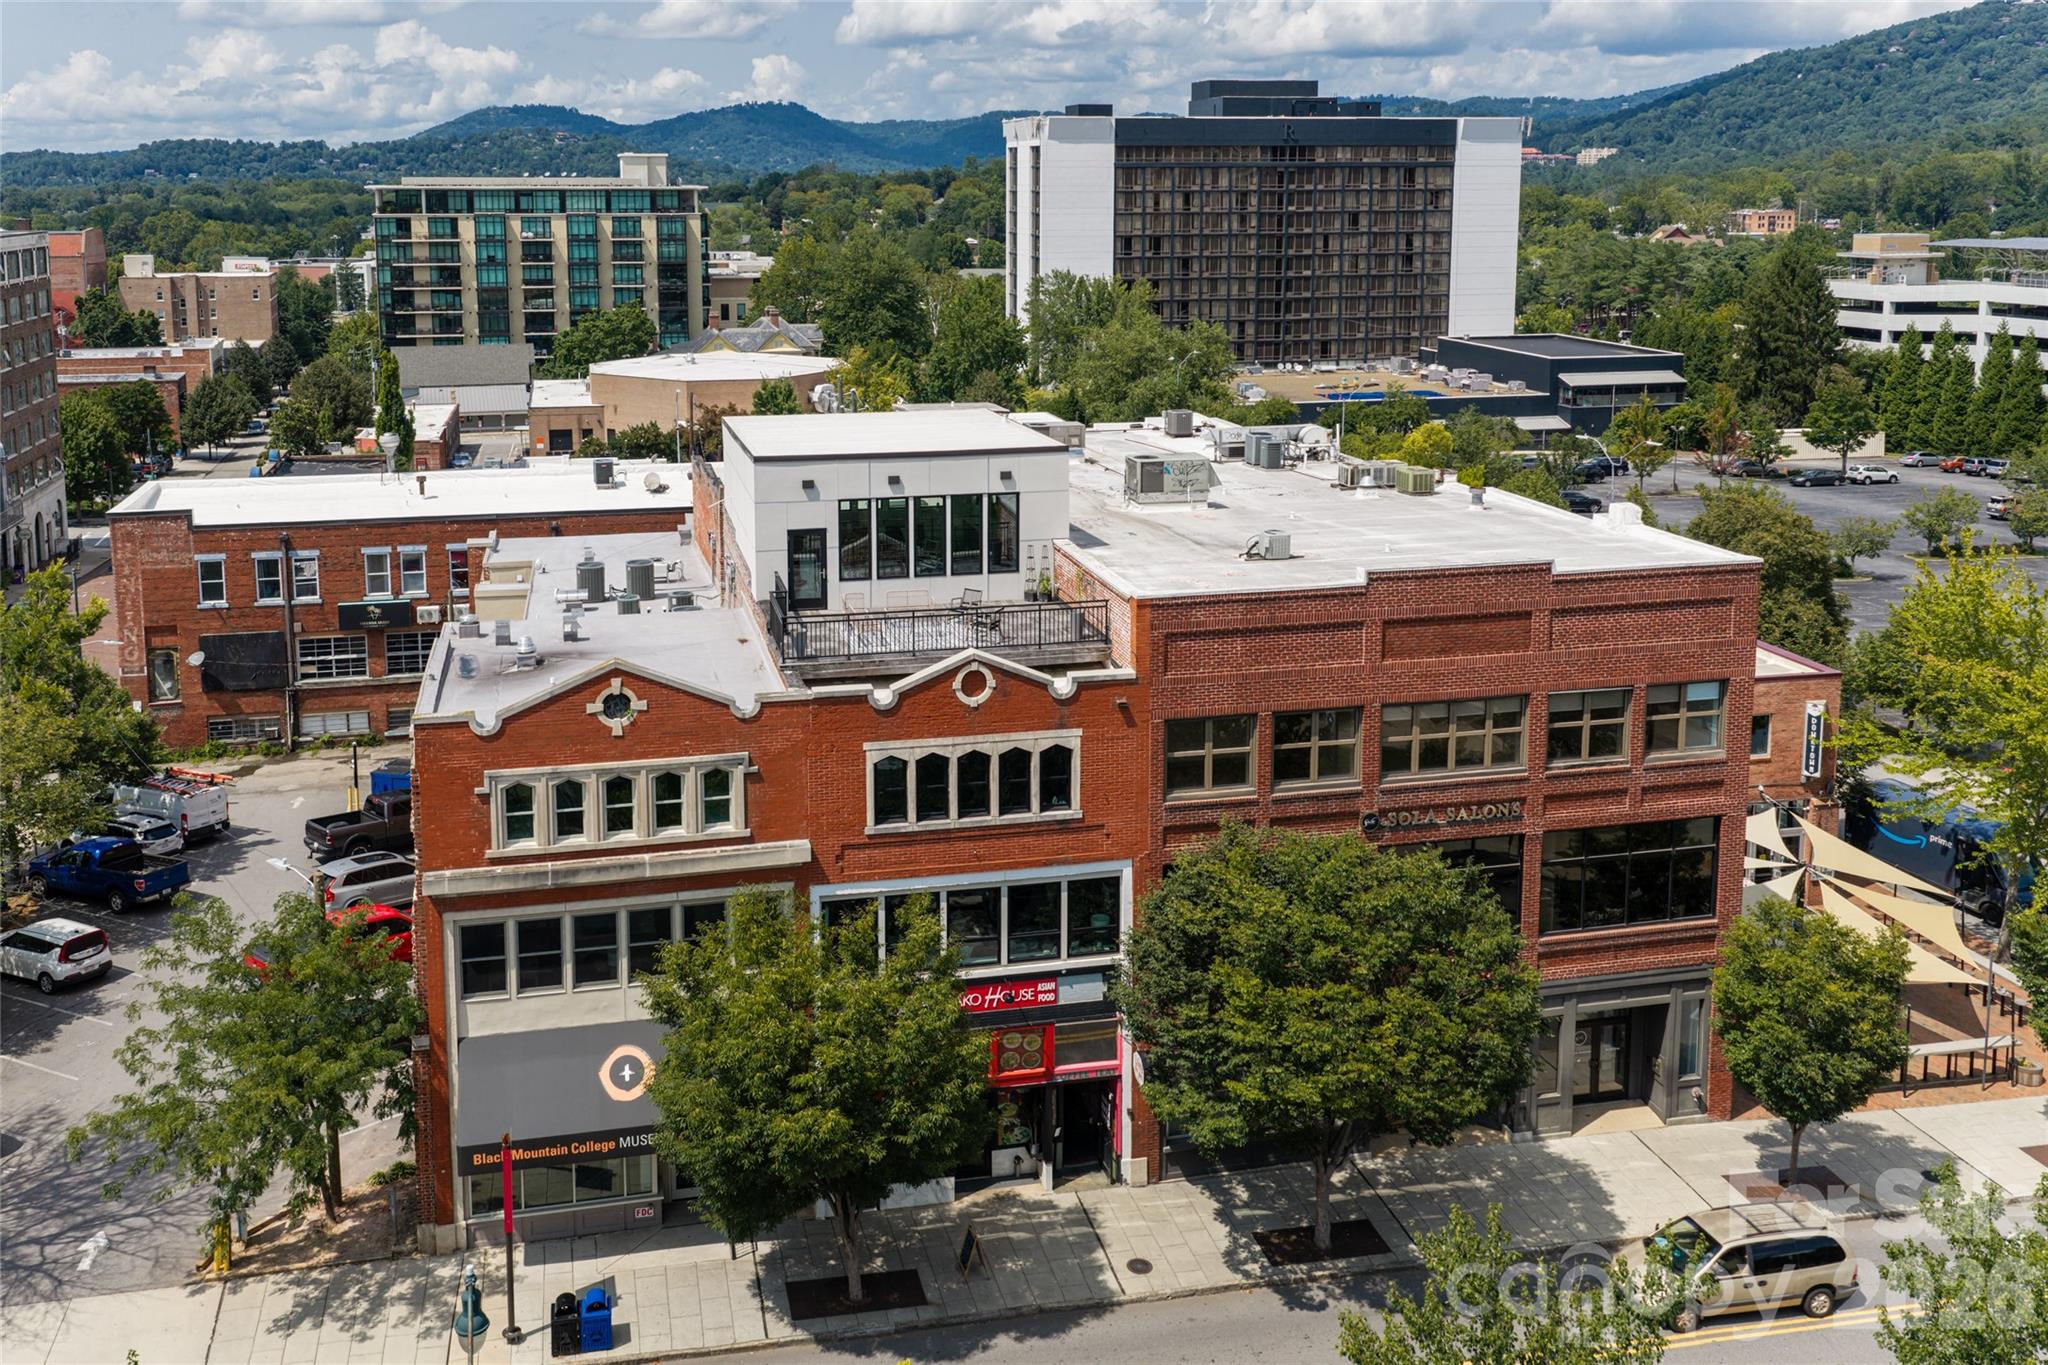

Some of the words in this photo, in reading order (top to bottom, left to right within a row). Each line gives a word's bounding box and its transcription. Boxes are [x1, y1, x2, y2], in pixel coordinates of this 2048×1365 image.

[1387, 808, 1439, 826] SOLA
[1445, 801, 1521, 823] SALONS
[1929, 834, 1953, 849] prime
[1037, 981, 1056, 992] ASIAN
[1037, 992, 1056, 1003] FOOD
[512, 1144, 568, 1160] Mountain
[571, 1139, 616, 1154] College
[636, 1207, 653, 1218] FDC
